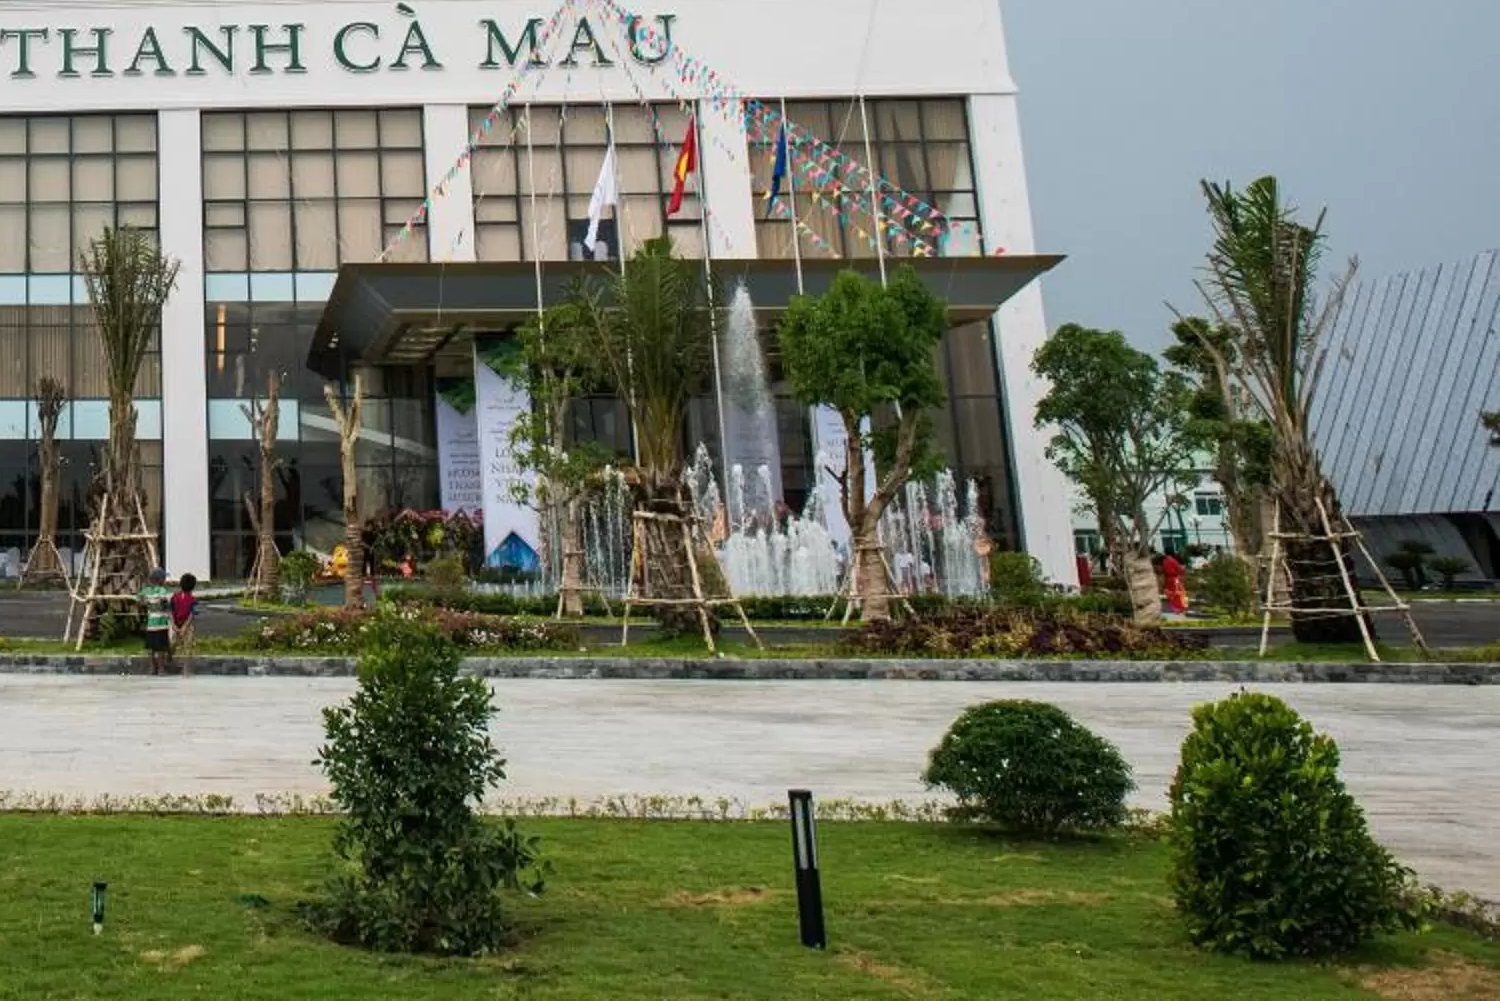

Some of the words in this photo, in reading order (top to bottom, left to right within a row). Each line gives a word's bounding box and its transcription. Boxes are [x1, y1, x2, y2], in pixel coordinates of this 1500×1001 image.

[0, 23, 308, 78] THANH
[333, 3, 444, 72] CÀ
[479, 14, 677, 70] MAU
